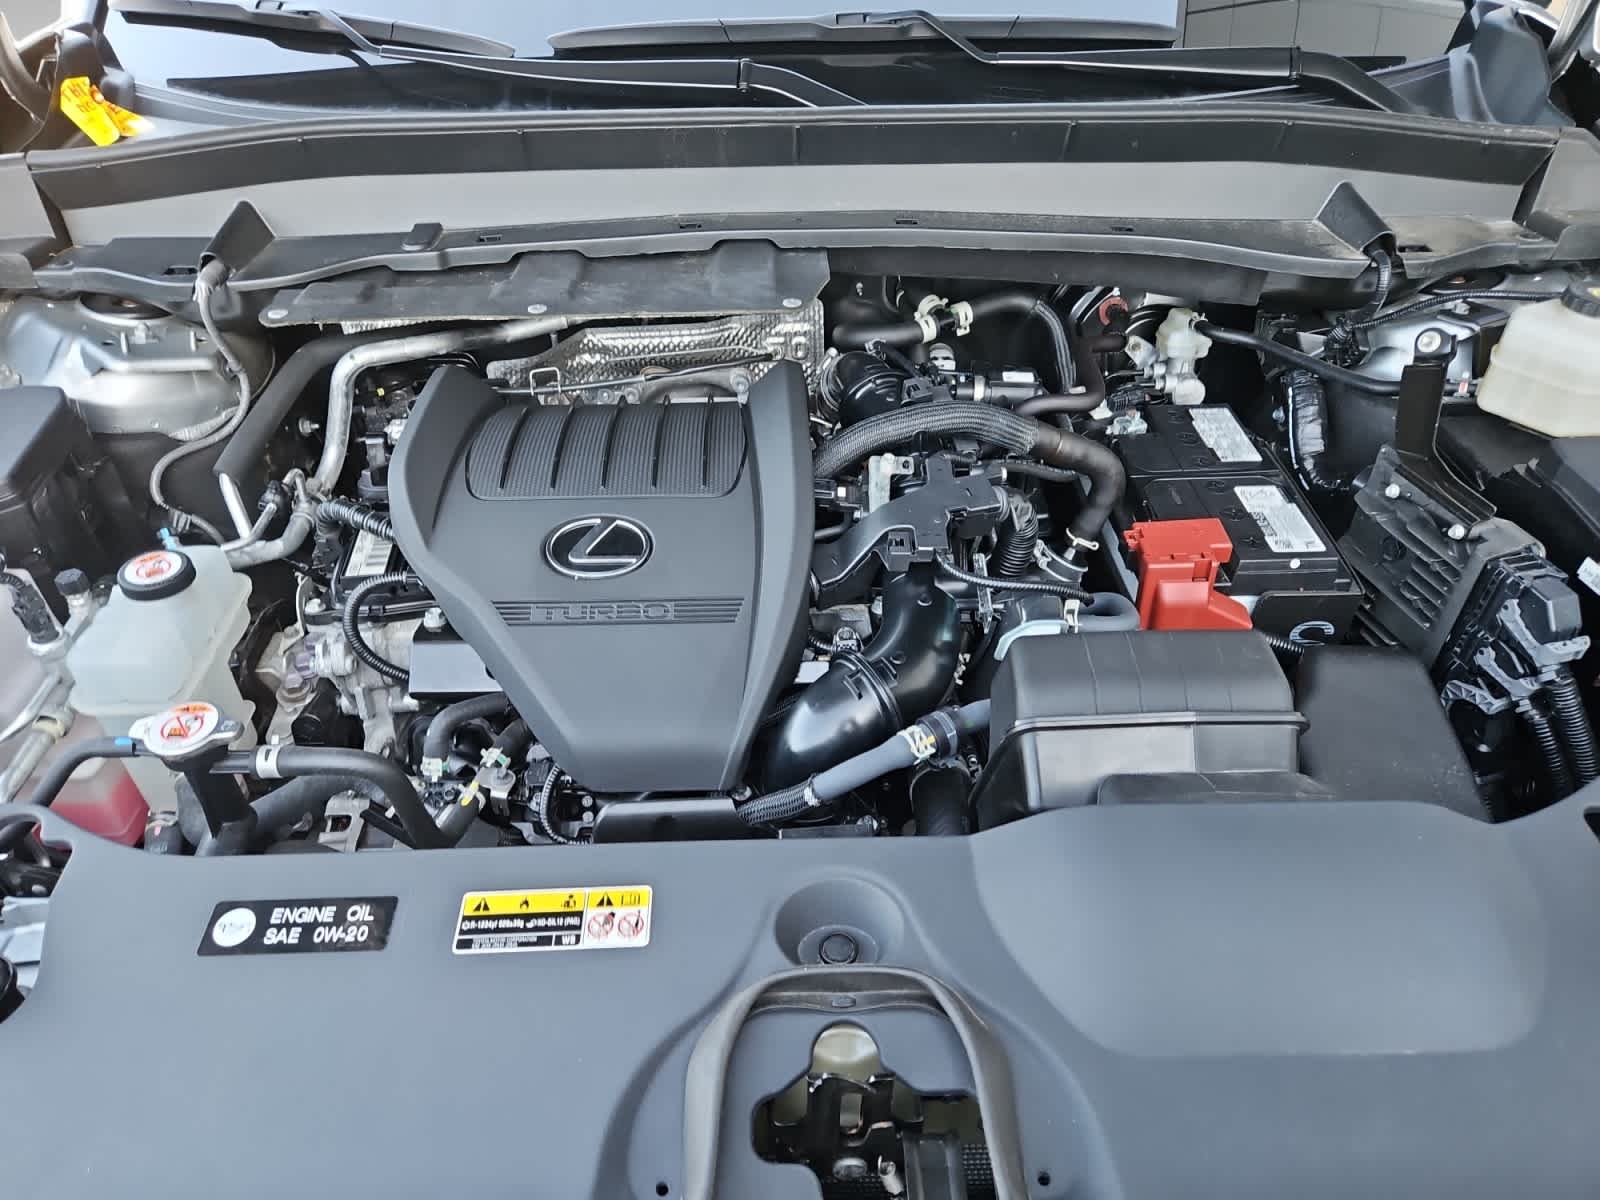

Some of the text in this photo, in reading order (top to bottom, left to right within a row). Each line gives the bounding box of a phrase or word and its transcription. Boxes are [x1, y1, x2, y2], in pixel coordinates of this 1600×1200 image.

[535, 602, 671, 621] TURBO
[270, 904, 374, 924] ENGINE OIL
[264, 927, 302, 945] SAE
[313, 925, 369, 944] 0W-20
